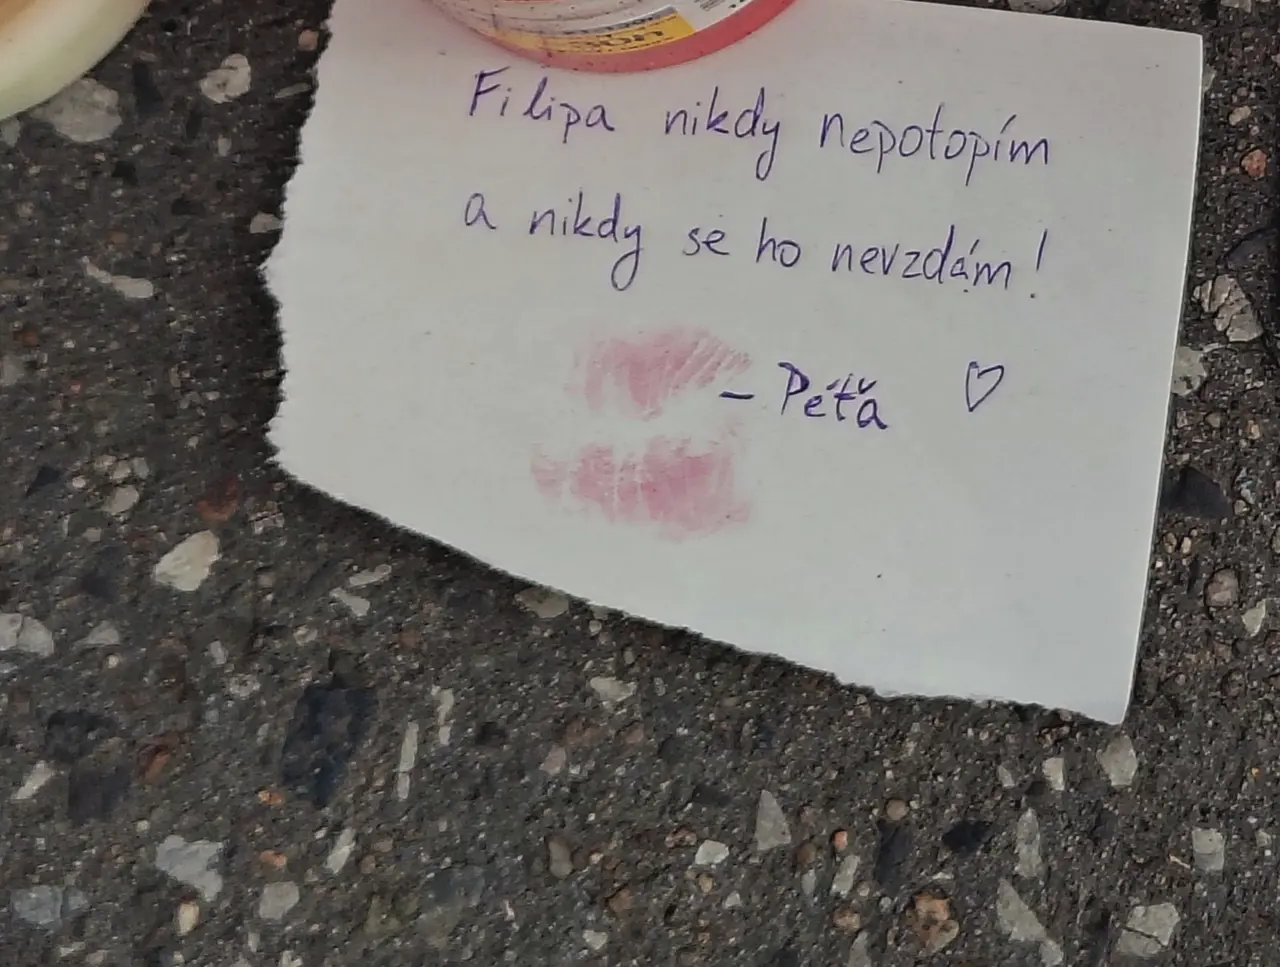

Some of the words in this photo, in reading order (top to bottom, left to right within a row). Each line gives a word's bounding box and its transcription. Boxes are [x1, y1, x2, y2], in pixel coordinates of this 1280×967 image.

[468, 65, 616, 144] Filipa
[665, 85, 781, 180] nikdy
[819, 103, 1050, 186] nepotopím
[463, 192, 497, 230] a
[529, 192, 643, 291] nikdy
[683, 225, 730, 257] se
[755, 217, 800, 269] ho
